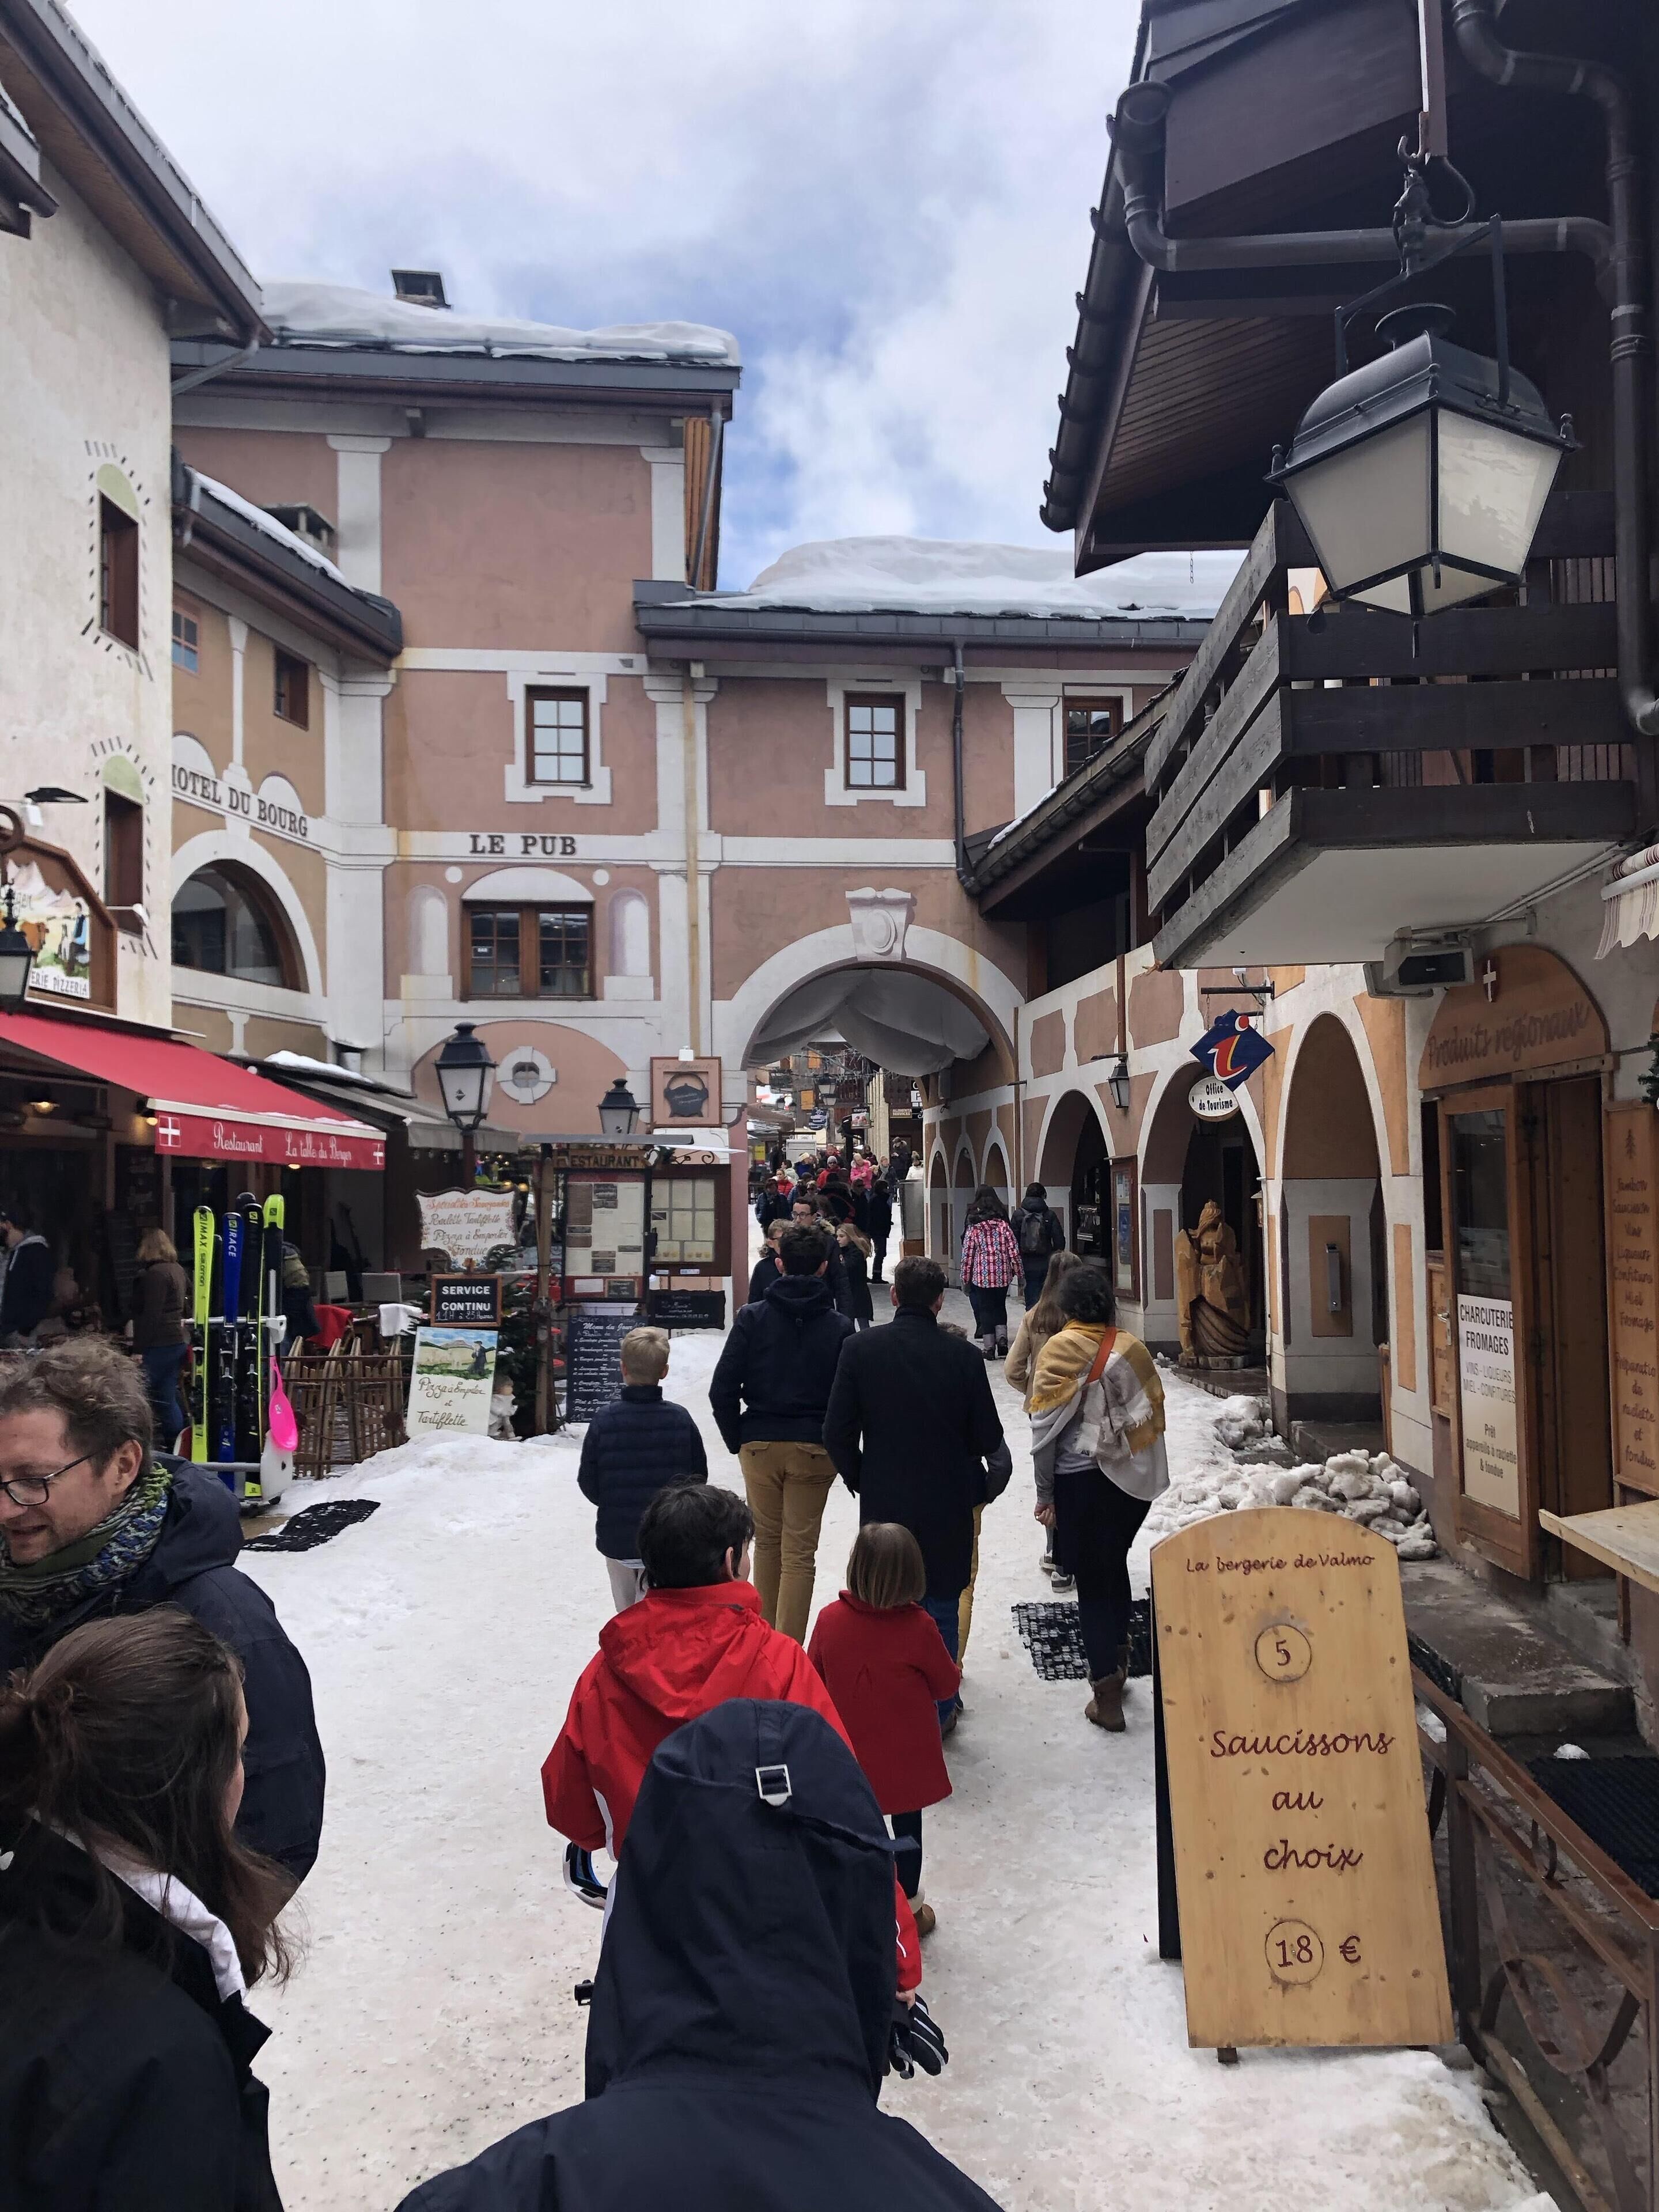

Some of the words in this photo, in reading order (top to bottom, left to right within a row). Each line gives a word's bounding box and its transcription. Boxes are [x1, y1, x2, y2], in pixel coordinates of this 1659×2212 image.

[228, 786, 251, 815] DU
[257, 798, 308, 836] BOURG
[469, 834, 505, 854] LE
[521, 835, 576, 855] PUB
[1206, 1082, 1224, 1096] Office
[1199, 1099, 1206, 1111] de
[1207, 1097, 1233, 1111] Tourisme
[213, 1122, 263, 1153] Restaurant
[286, 1131, 297, 1157] La
[442, 1286, 490, 1295] SERVICE
[441, 1302, 491, 1311] CONTINU
[1460, 1304, 1514, 1330] CHARCUTERIE
[1466, 1331, 1509, 1355] FROMAGES
[418, 1377, 446, 1399] Pizza
[416, 1411, 469, 1430] Tartiflette
[1186, 1558, 1210, 1573] La
[1216, 1556, 1287, 1575] bergerie
[1294, 1554, 1317, 1569] de
[1318, 1552, 1376, 1567] Valmo
[1275, 1639, 1291, 1666] 5
[1210, 1729, 1396, 1758] Saucissons
[1271, 1790, 1324, 1811] au
[1263, 1839, 1364, 1871] choix
[1275, 1934, 1313, 1968] 18
[1338, 1935, 1361, 1964] €
